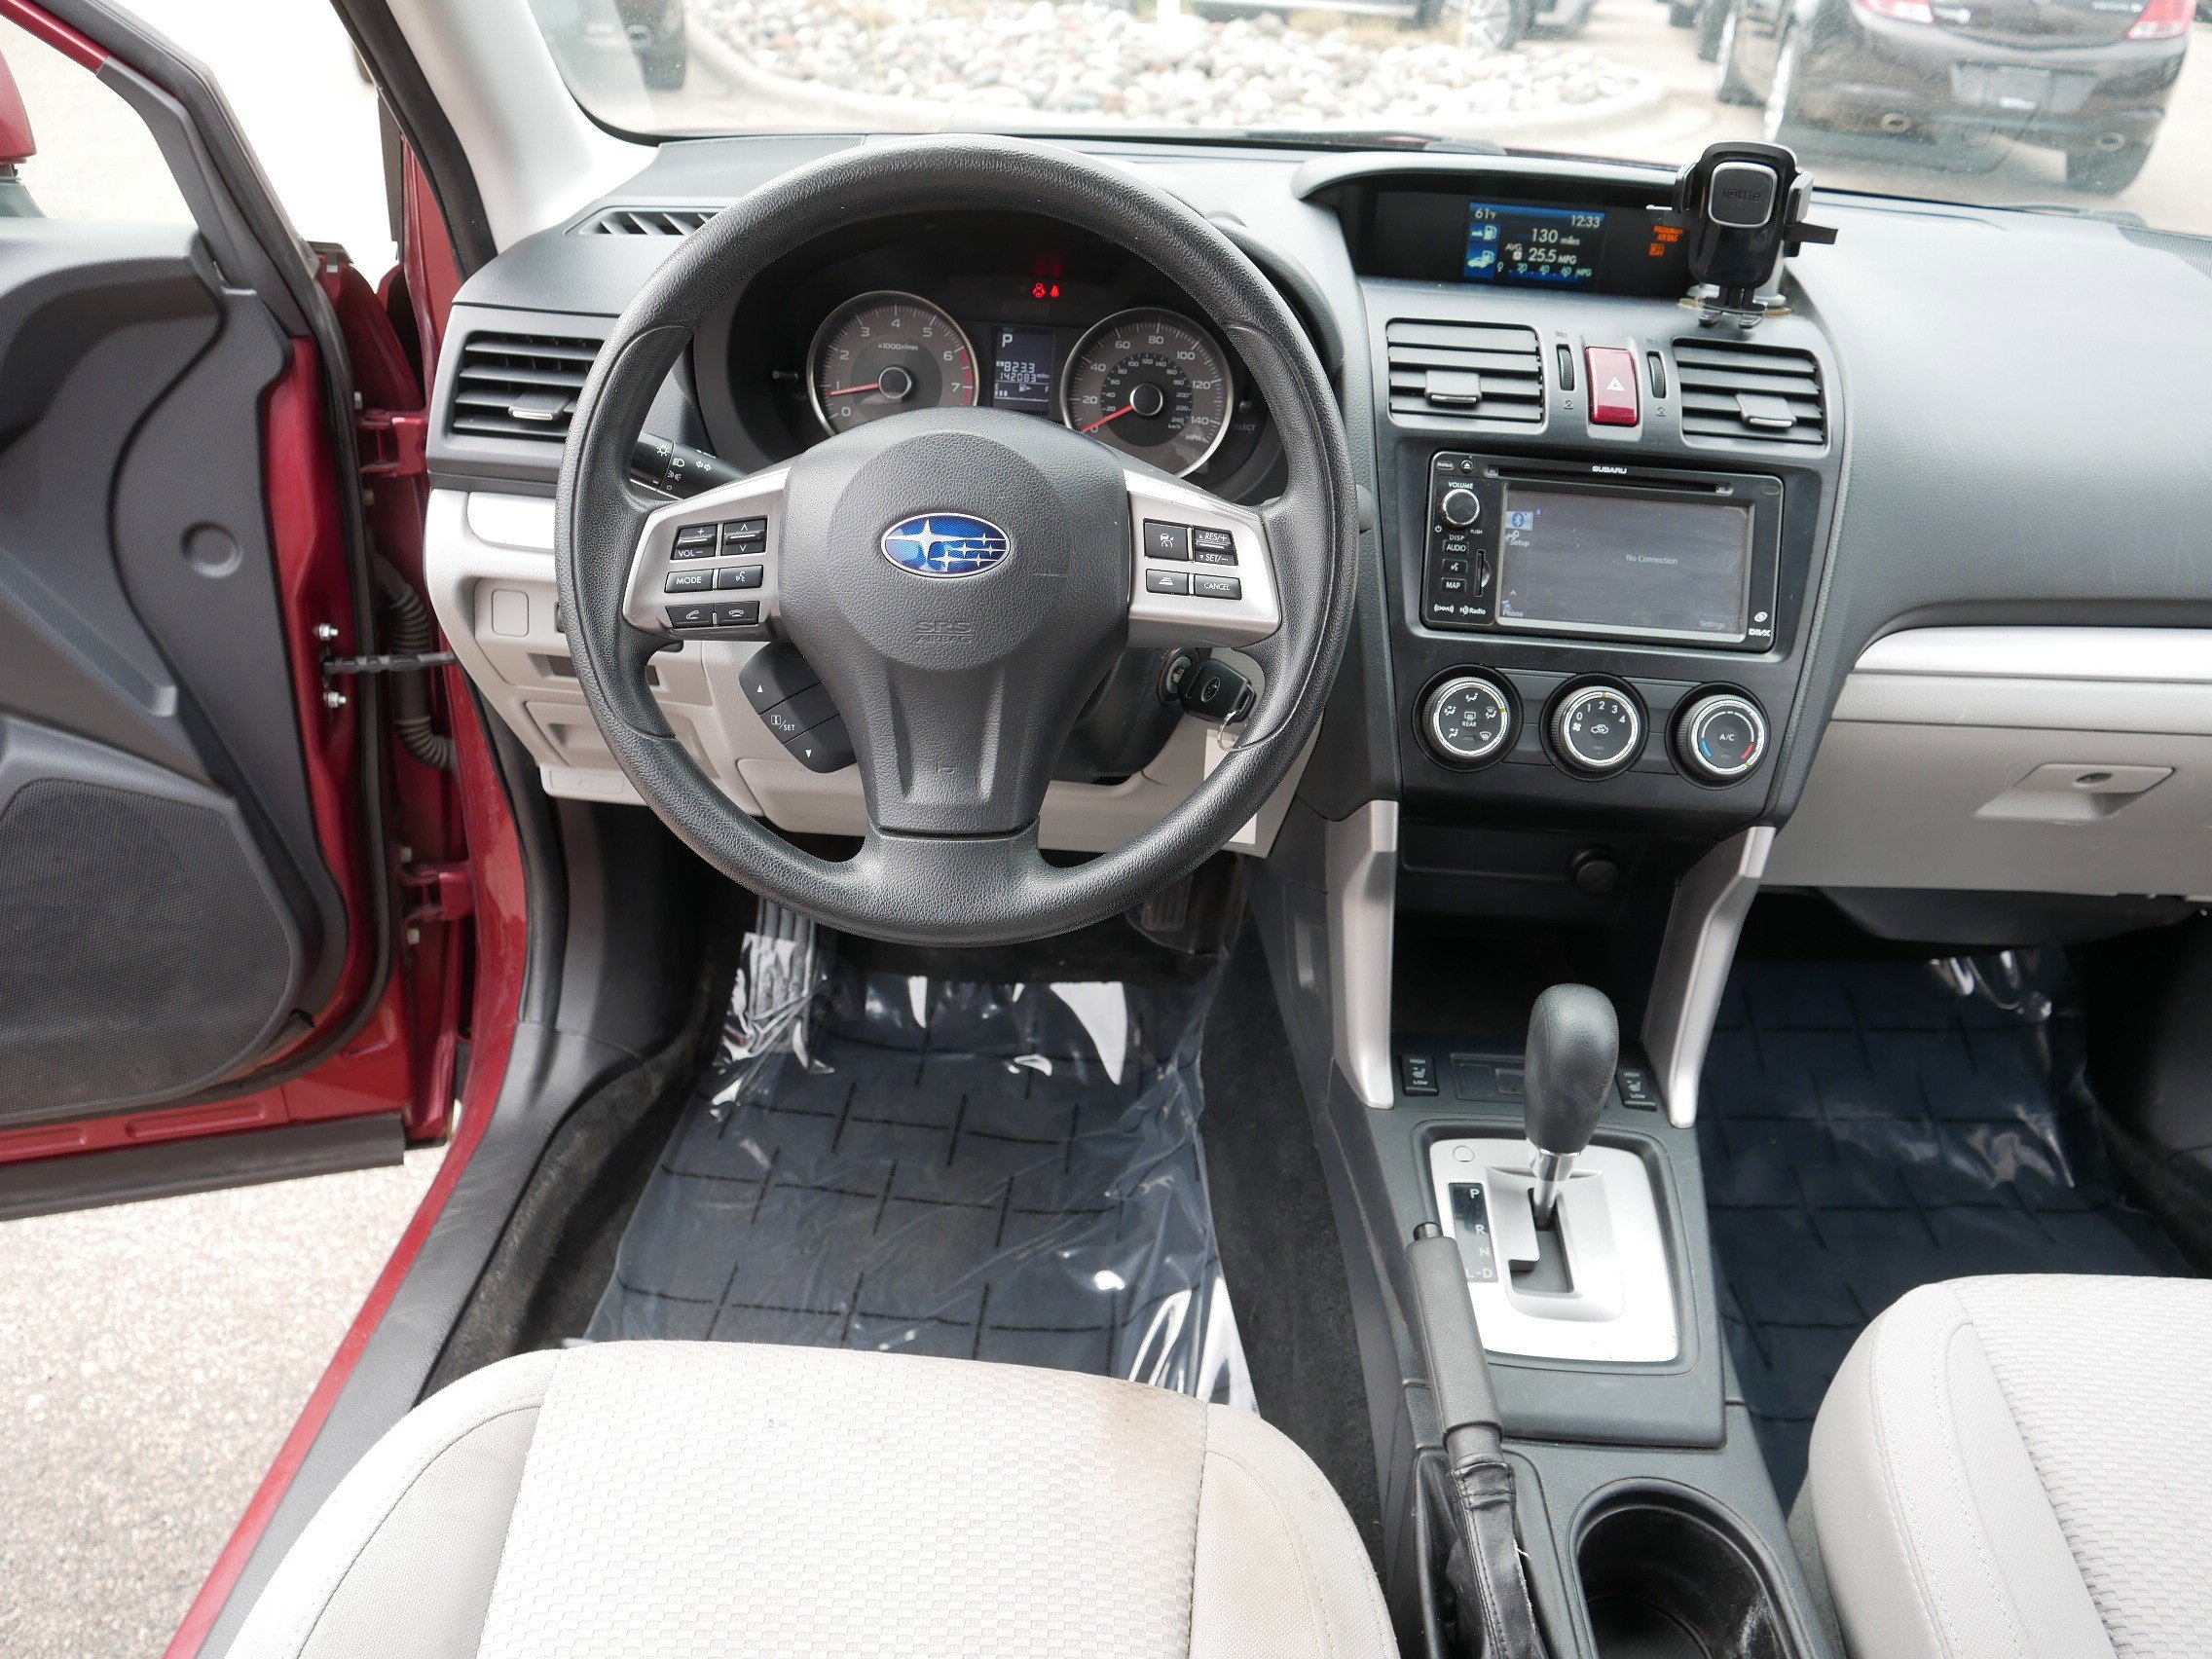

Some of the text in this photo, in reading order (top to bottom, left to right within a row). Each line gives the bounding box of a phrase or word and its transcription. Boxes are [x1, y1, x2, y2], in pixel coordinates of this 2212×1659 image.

[1531, 227, 1580, 245] 130 miles
[1529, 247, 1577, 265] 25.5 MPG
[891, 318, 901, 329] 4
[861, 327, 869, 337] 3
[923, 327, 933, 338] 5
[1002, 333, 1014, 348] P
[1115, 341, 1131, 350] 60
[1148, 336, 1164, 345] 80
[839, 350, 849, 360] 2
[943, 350, 953, 361] 6
[1176, 350, 1197, 361] 100
[1089, 363, 1107, 372] 40
[1000, 372, 1037, 384] 142083
[951, 382, 961, 392] 7
[1192, 381, 1211, 389] 120
[1082, 395, 1098, 405] 20
[841, 407, 851, 417] 0
[1191, 416, 1209, 425] 140
[1592, 465, 1627, 474] SUBARU
[1448, 481, 1474, 490] VOLUME
[1446, 543, 1467, 552] AUDIO
[1510, 539, 1530, 548] Setup
[1626, 553, 1678, 566] No Connection
[676, 575, 702, 585] MODE
[1203, 581, 1231, 591] CANCEL
[1502, 608, 1525, 618] Phone
[915, 620, 973, 633] SRS
[1576, 700, 1626, 723] 0 1 2 3 4
[1719, 733, 1735, 742] A/C
[1469, 1189, 1480, 1198] P
[1475, 1224, 1486, 1235] R
[1479, 1247, 1490, 1256] N
